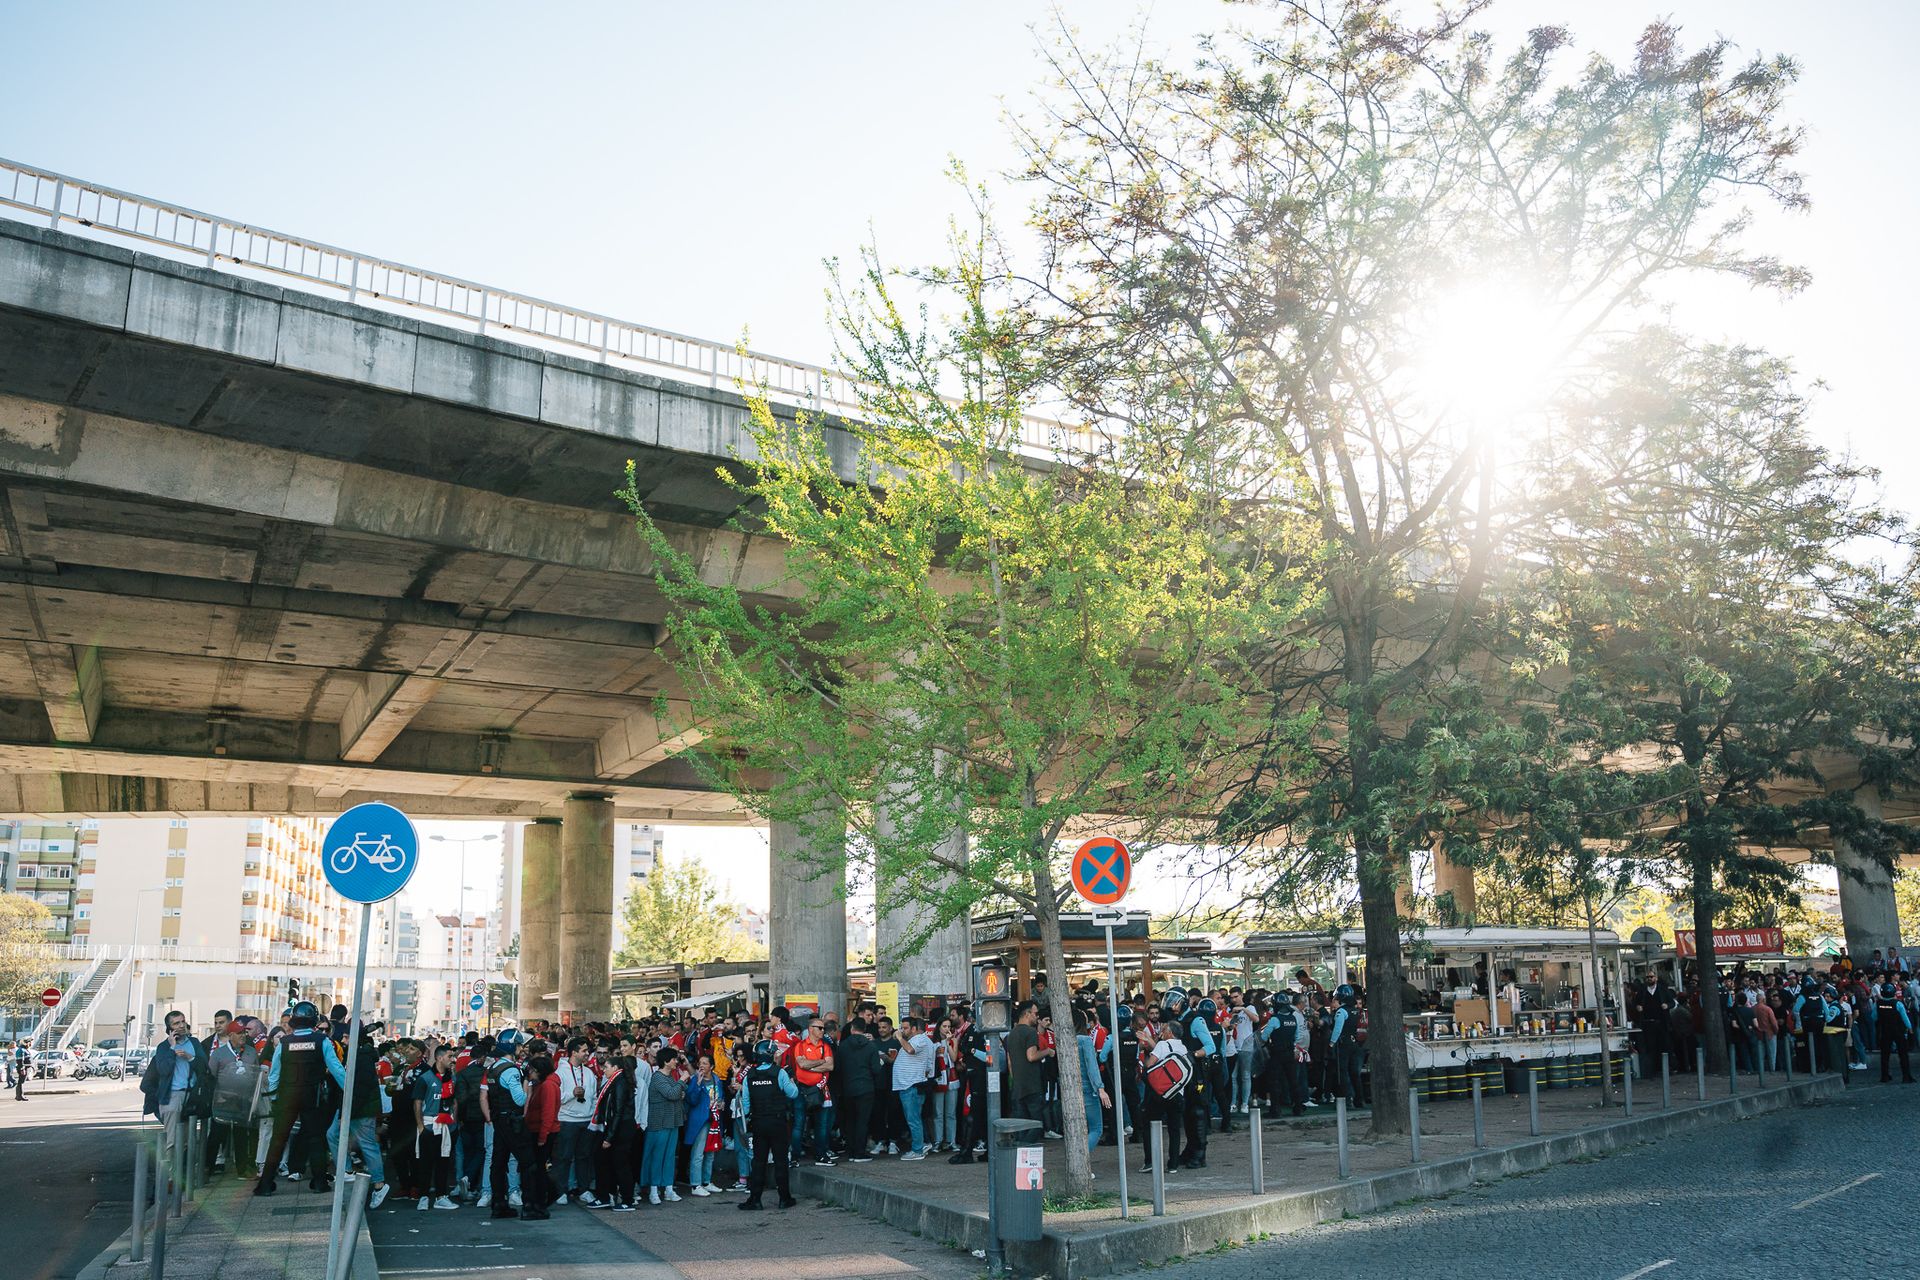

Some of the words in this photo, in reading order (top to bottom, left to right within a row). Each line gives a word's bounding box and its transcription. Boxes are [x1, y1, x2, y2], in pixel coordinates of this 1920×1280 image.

[1713, 935, 1743, 947] OULOTE
[1744, 934, 1763, 946] NAIA
[475, 983, 484, 991] 20
